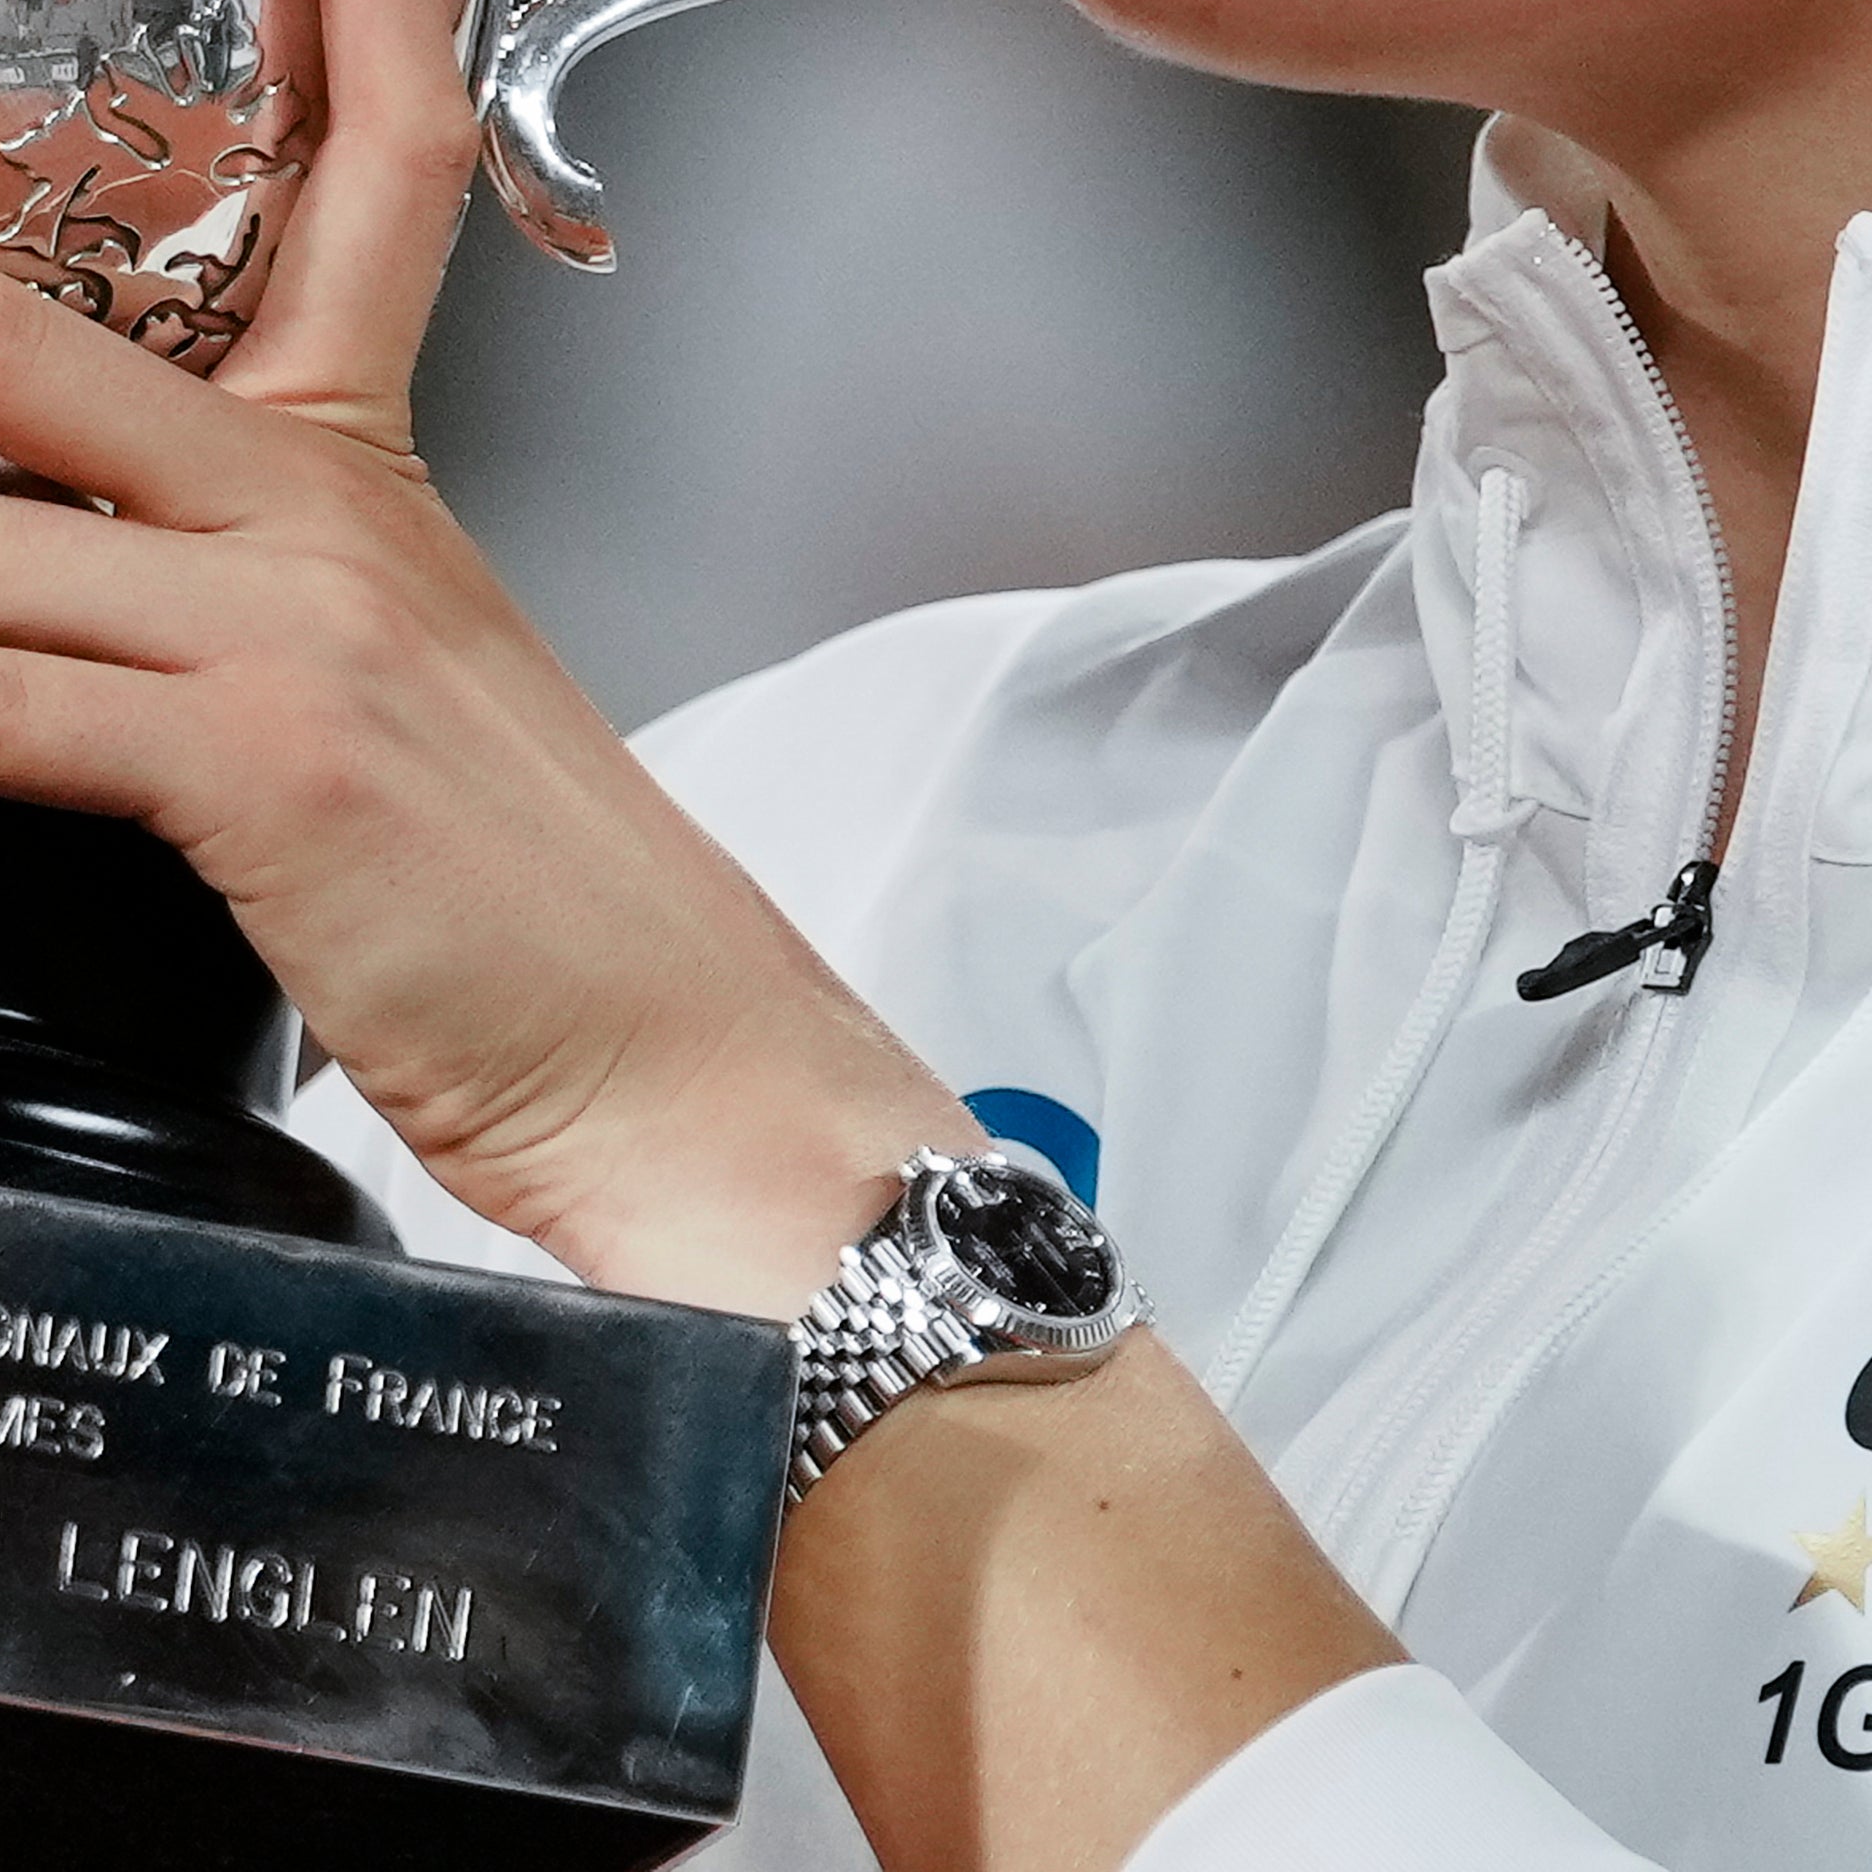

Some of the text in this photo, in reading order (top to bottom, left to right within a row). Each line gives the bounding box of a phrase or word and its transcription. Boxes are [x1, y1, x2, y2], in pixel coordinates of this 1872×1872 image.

[209, 1340, 288, 1407] DE
[326, 1354, 564, 1453] FRANCE
[57, 1522, 474, 1662] LENGLEN
